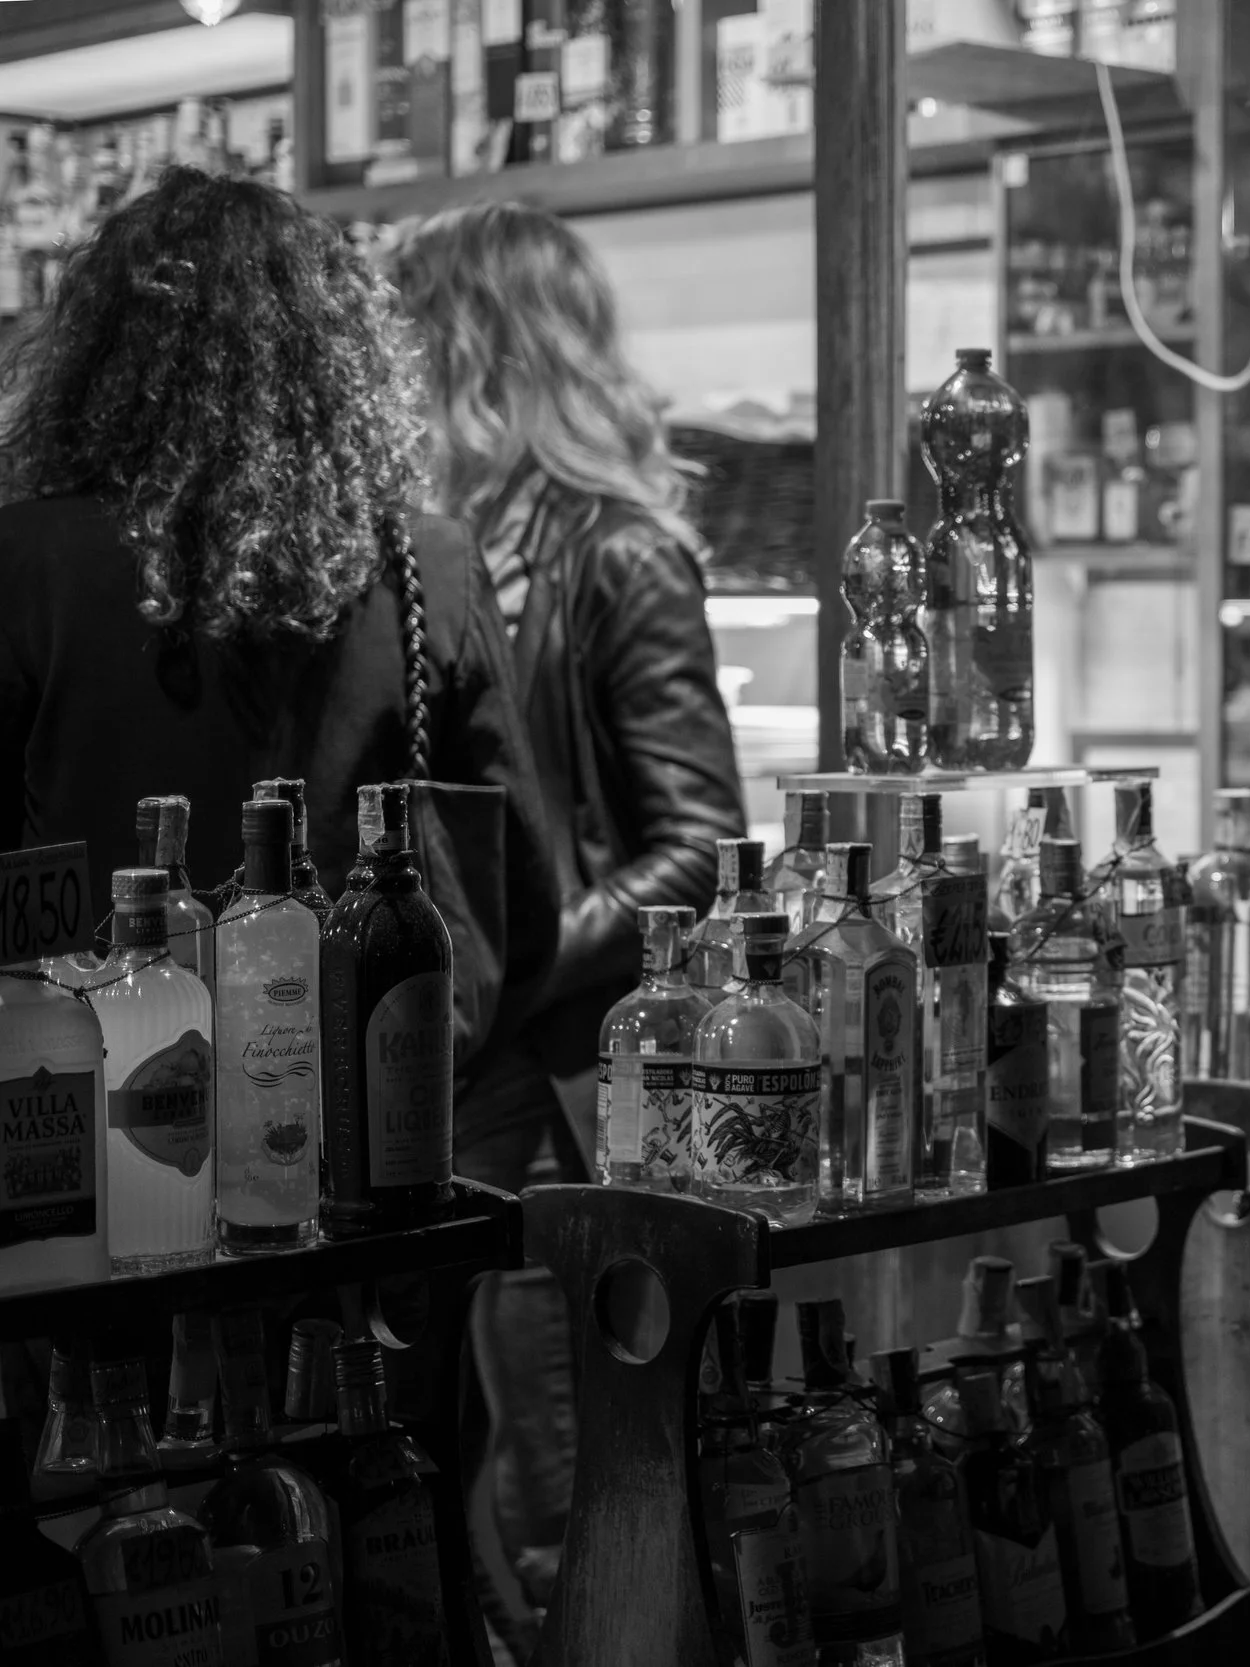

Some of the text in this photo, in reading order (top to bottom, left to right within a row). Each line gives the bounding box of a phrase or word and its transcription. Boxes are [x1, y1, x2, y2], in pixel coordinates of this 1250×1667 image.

[731, 1084, 755, 1093] AGAVE
[732, 1074, 755, 1085] PURO
[8, 1092, 79, 1119] VILLA
[4, 1113, 86, 1143] MASSA
[278, 1562, 323, 1610] 12
[268, 1617, 335, 1648] OUZO
